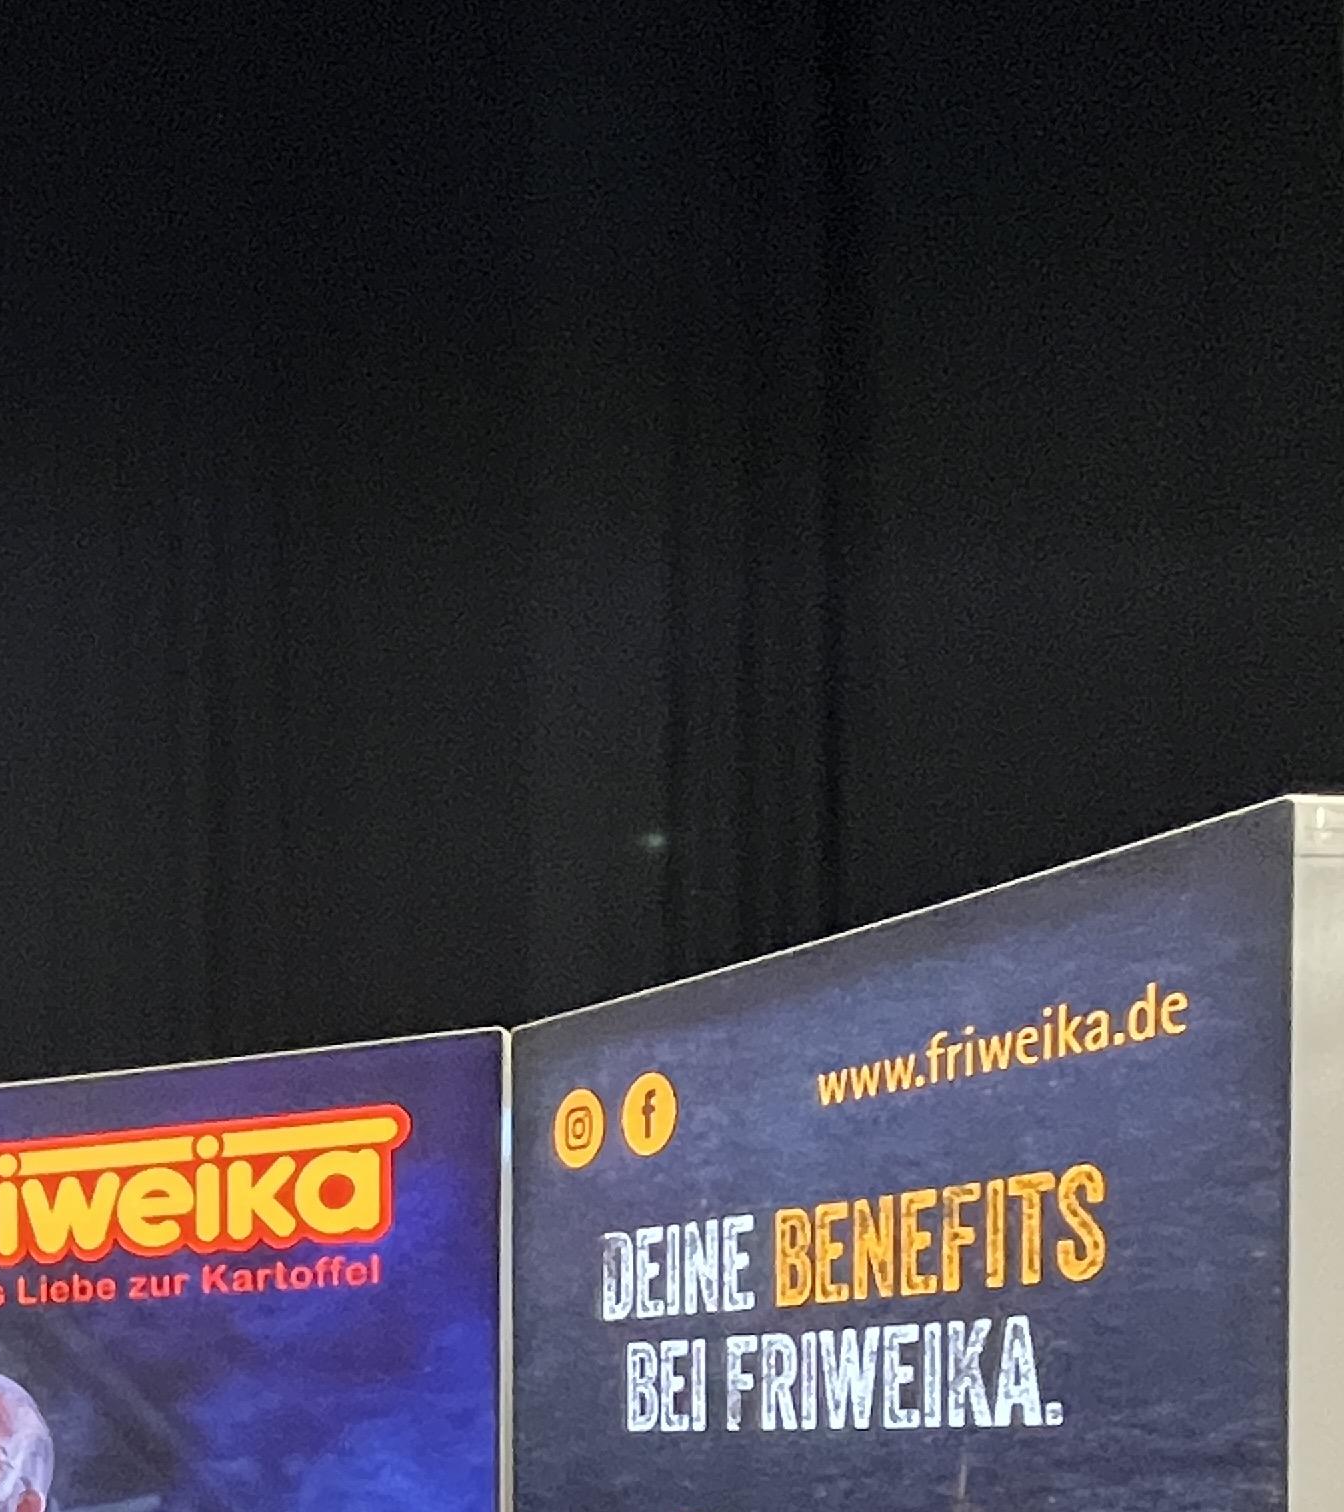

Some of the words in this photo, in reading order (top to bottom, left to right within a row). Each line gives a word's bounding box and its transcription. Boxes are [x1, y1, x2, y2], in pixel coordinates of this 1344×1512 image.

[818, 982, 1188, 1106] www.friweika.de
[16, 1272, 117, 1306] Liebe
[128, 1271, 190, 1299] zur
[201, 1253, 382, 1295] Kartoffel
[601, 1214, 756, 1321] DEINE
[773, 1163, 1108, 1308] BENEFITS
[626, 1338, 706, 1432] BEI
[725, 1314, 1064, 1433] FRIWEIKA.
